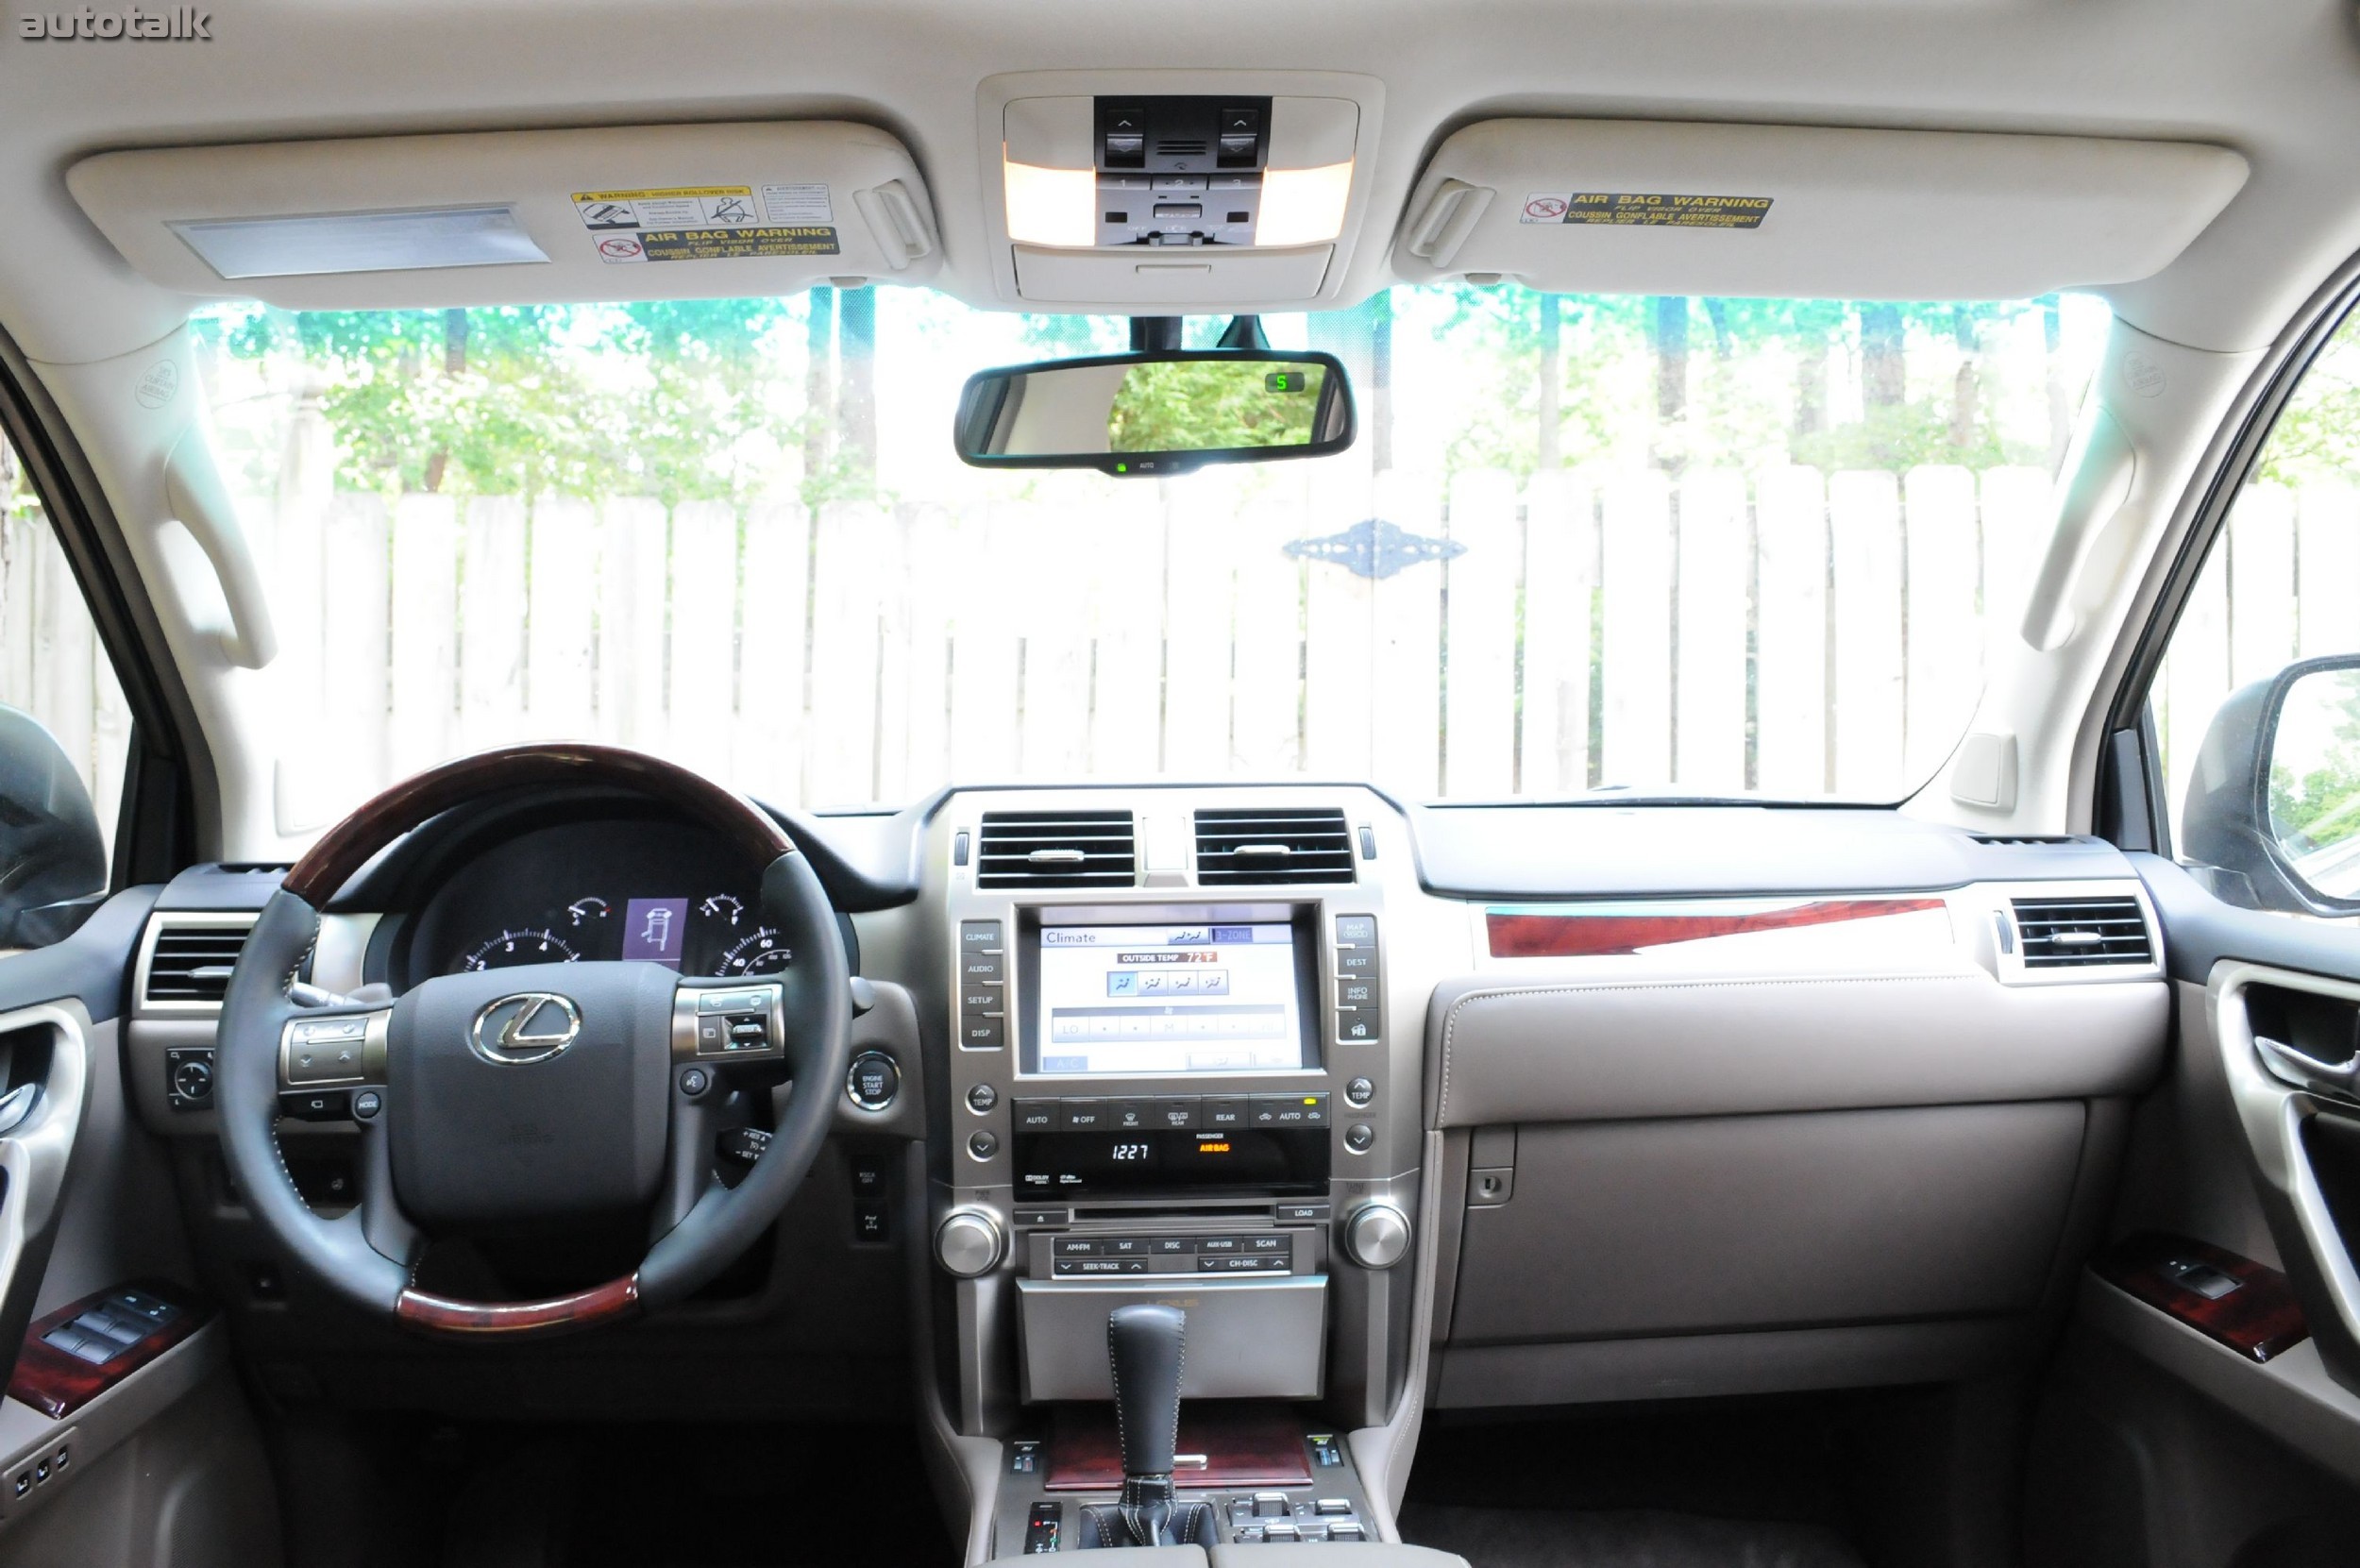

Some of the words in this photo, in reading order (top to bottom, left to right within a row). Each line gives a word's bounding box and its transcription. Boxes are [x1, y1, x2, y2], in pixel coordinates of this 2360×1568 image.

[1120, 178, 1126, 187] 1
[1174, 178, 1184, 187] 2
[1233, 178, 1241, 187] 3
[1575, 194, 1609, 204] AIR
[1617, 195, 1661, 205] BAG
[1674, 196, 1769, 208] WARNING
[1677, 213, 1761, 223] AVERTISSEMENT
[645, 232, 678, 242] AIR
[685, 230, 729, 240] BAG
[736, 228, 832, 238] WARNING
[648, 248, 690, 257] COUSSIN
[695, 244, 752, 254] GONFLABLE
[758, 243, 834, 252] AVERTISSEMENT
[965, 933, 994, 941] CLIMATE
[1046, 932, 1096, 944] Climate
[1216, 930, 1252, 941] 3-ZONE
[505, 941, 514, 953] 3
[538, 940, 548, 952] 4
[760, 938, 773, 949] 60
[733, 957, 746, 968] 40
[1121, 953, 1156, 963] OUTSIDE
[1159, 953, 1179, 962] TEMP
[1346, 958, 1367, 967] DEST
[477, 960, 486, 971] 2
[968, 965, 994, 973] AUDIO
[968, 996, 993, 1004] SETUP
[971, 1029, 991, 1037] DISP
[1352, 1091, 1371, 1100] TEMP
[359, 1101, 378, 1109] MODE
[973, 1098, 993, 1106] TEMP
[1026, 1116, 1048, 1124] AUTO
[1279, 1112, 1301, 1121] AUTO
[1294, 1209, 1313, 1218] LOAD
[1256, 1239, 1277, 1248] SCAN
